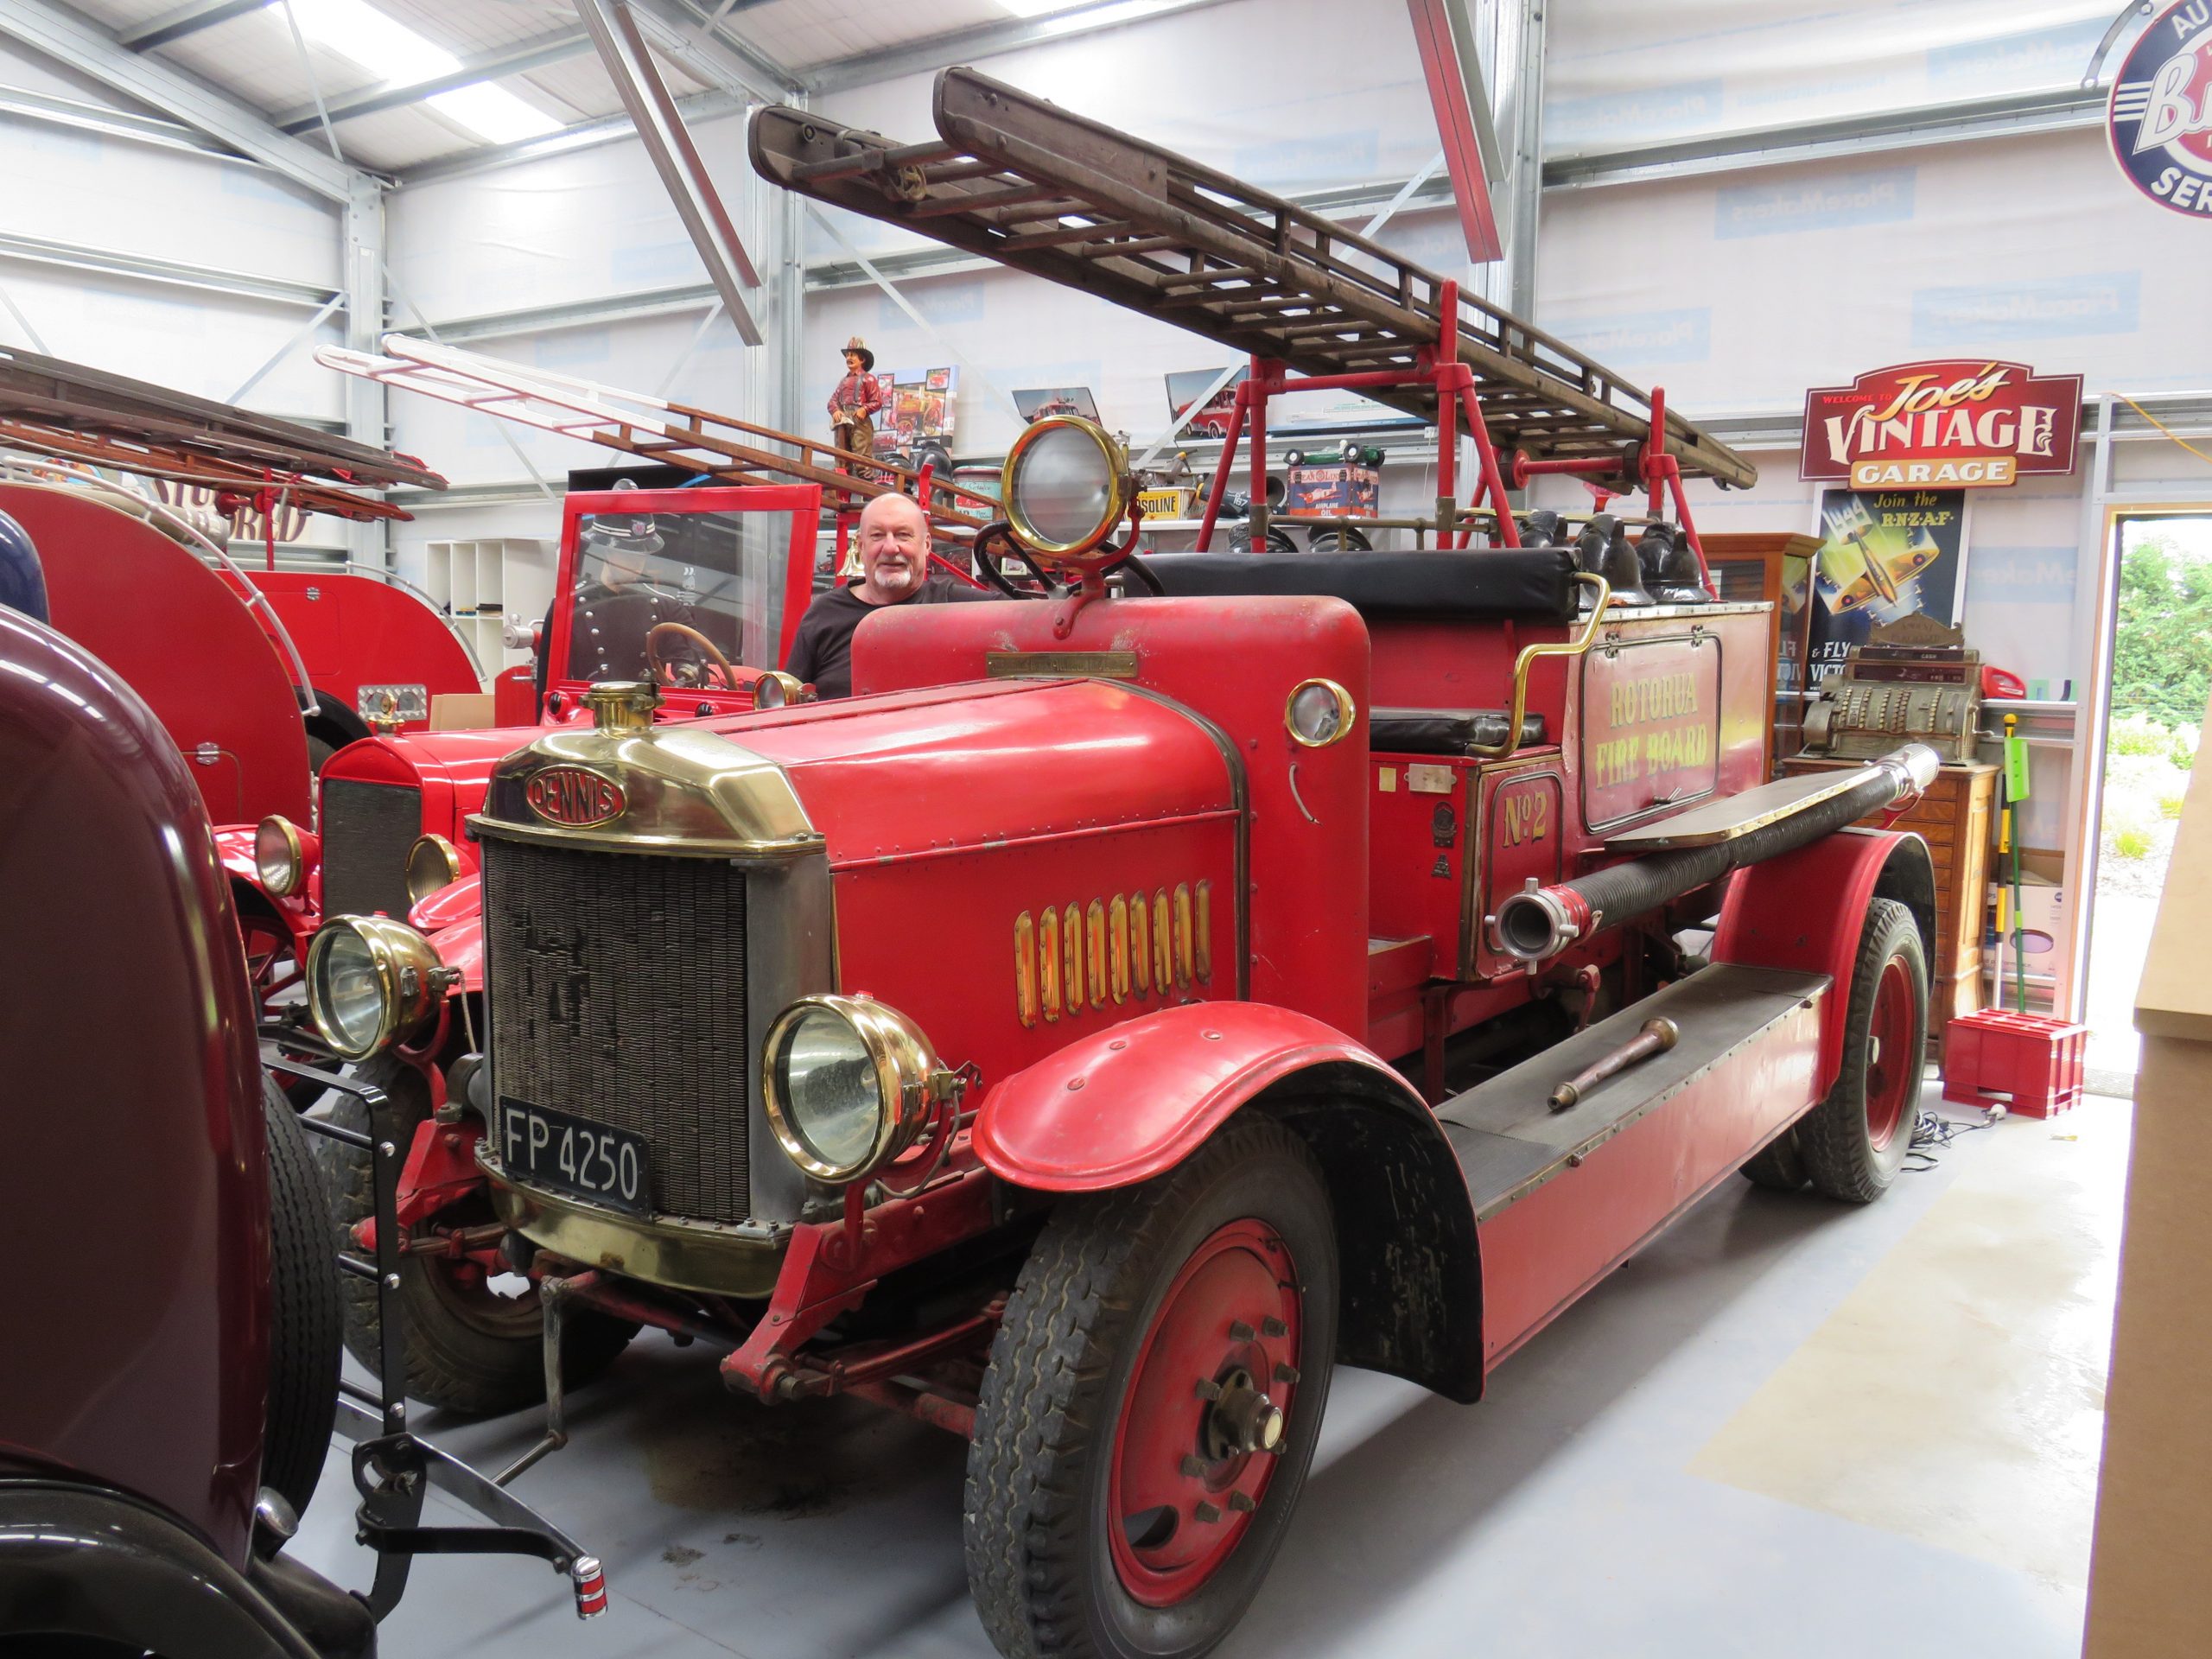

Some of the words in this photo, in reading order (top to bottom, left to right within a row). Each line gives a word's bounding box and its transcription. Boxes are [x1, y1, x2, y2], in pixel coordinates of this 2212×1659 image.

[1822, 393, 1874, 404] WELCOME
[1878, 393, 1892, 402] TO
[1866, 361, 2012, 422] Joe's
[1823, 404, 2058, 465] VINTAGE
[1857, 461, 2009, 485] GARAGE
[1873, 493, 1905, 508] Join
[1914, 491, 1938, 507] the
[1811, 647, 1821, 658] &
[1822, 641, 1852, 658] FLY
[1610, 672, 1699, 728] ROTORUA
[1595, 736, 1640, 790] FIRE
[1646, 723, 1708, 777] BOARD
[531, 768, 615, 824] DENNIS
[505, 1109, 549, 1170] FP
[559, 1126, 639, 1201] 4250
